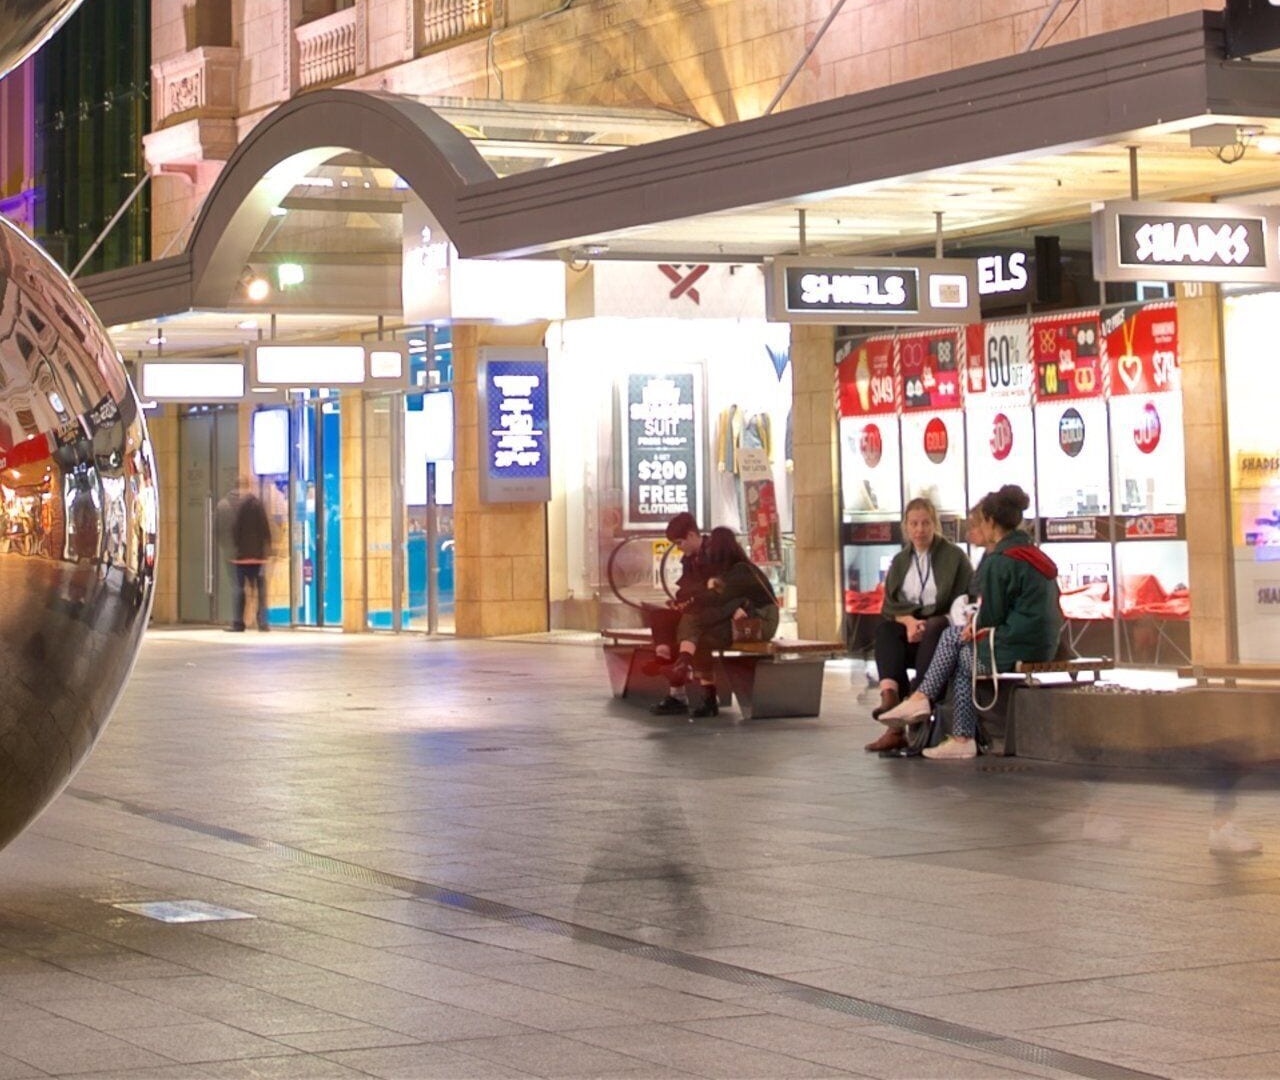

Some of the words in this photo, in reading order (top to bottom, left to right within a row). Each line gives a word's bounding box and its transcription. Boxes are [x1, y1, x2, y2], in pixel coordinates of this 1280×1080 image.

[1134, 222, 1250, 265] SHADES
[644, 419, 681, 437] SUIT
[637, 459, 688, 481] $200
[1241, 457, 1280, 470] SHADES
[638, 485, 688, 504] FREE
[638, 503, 689, 515] CLOTHING
